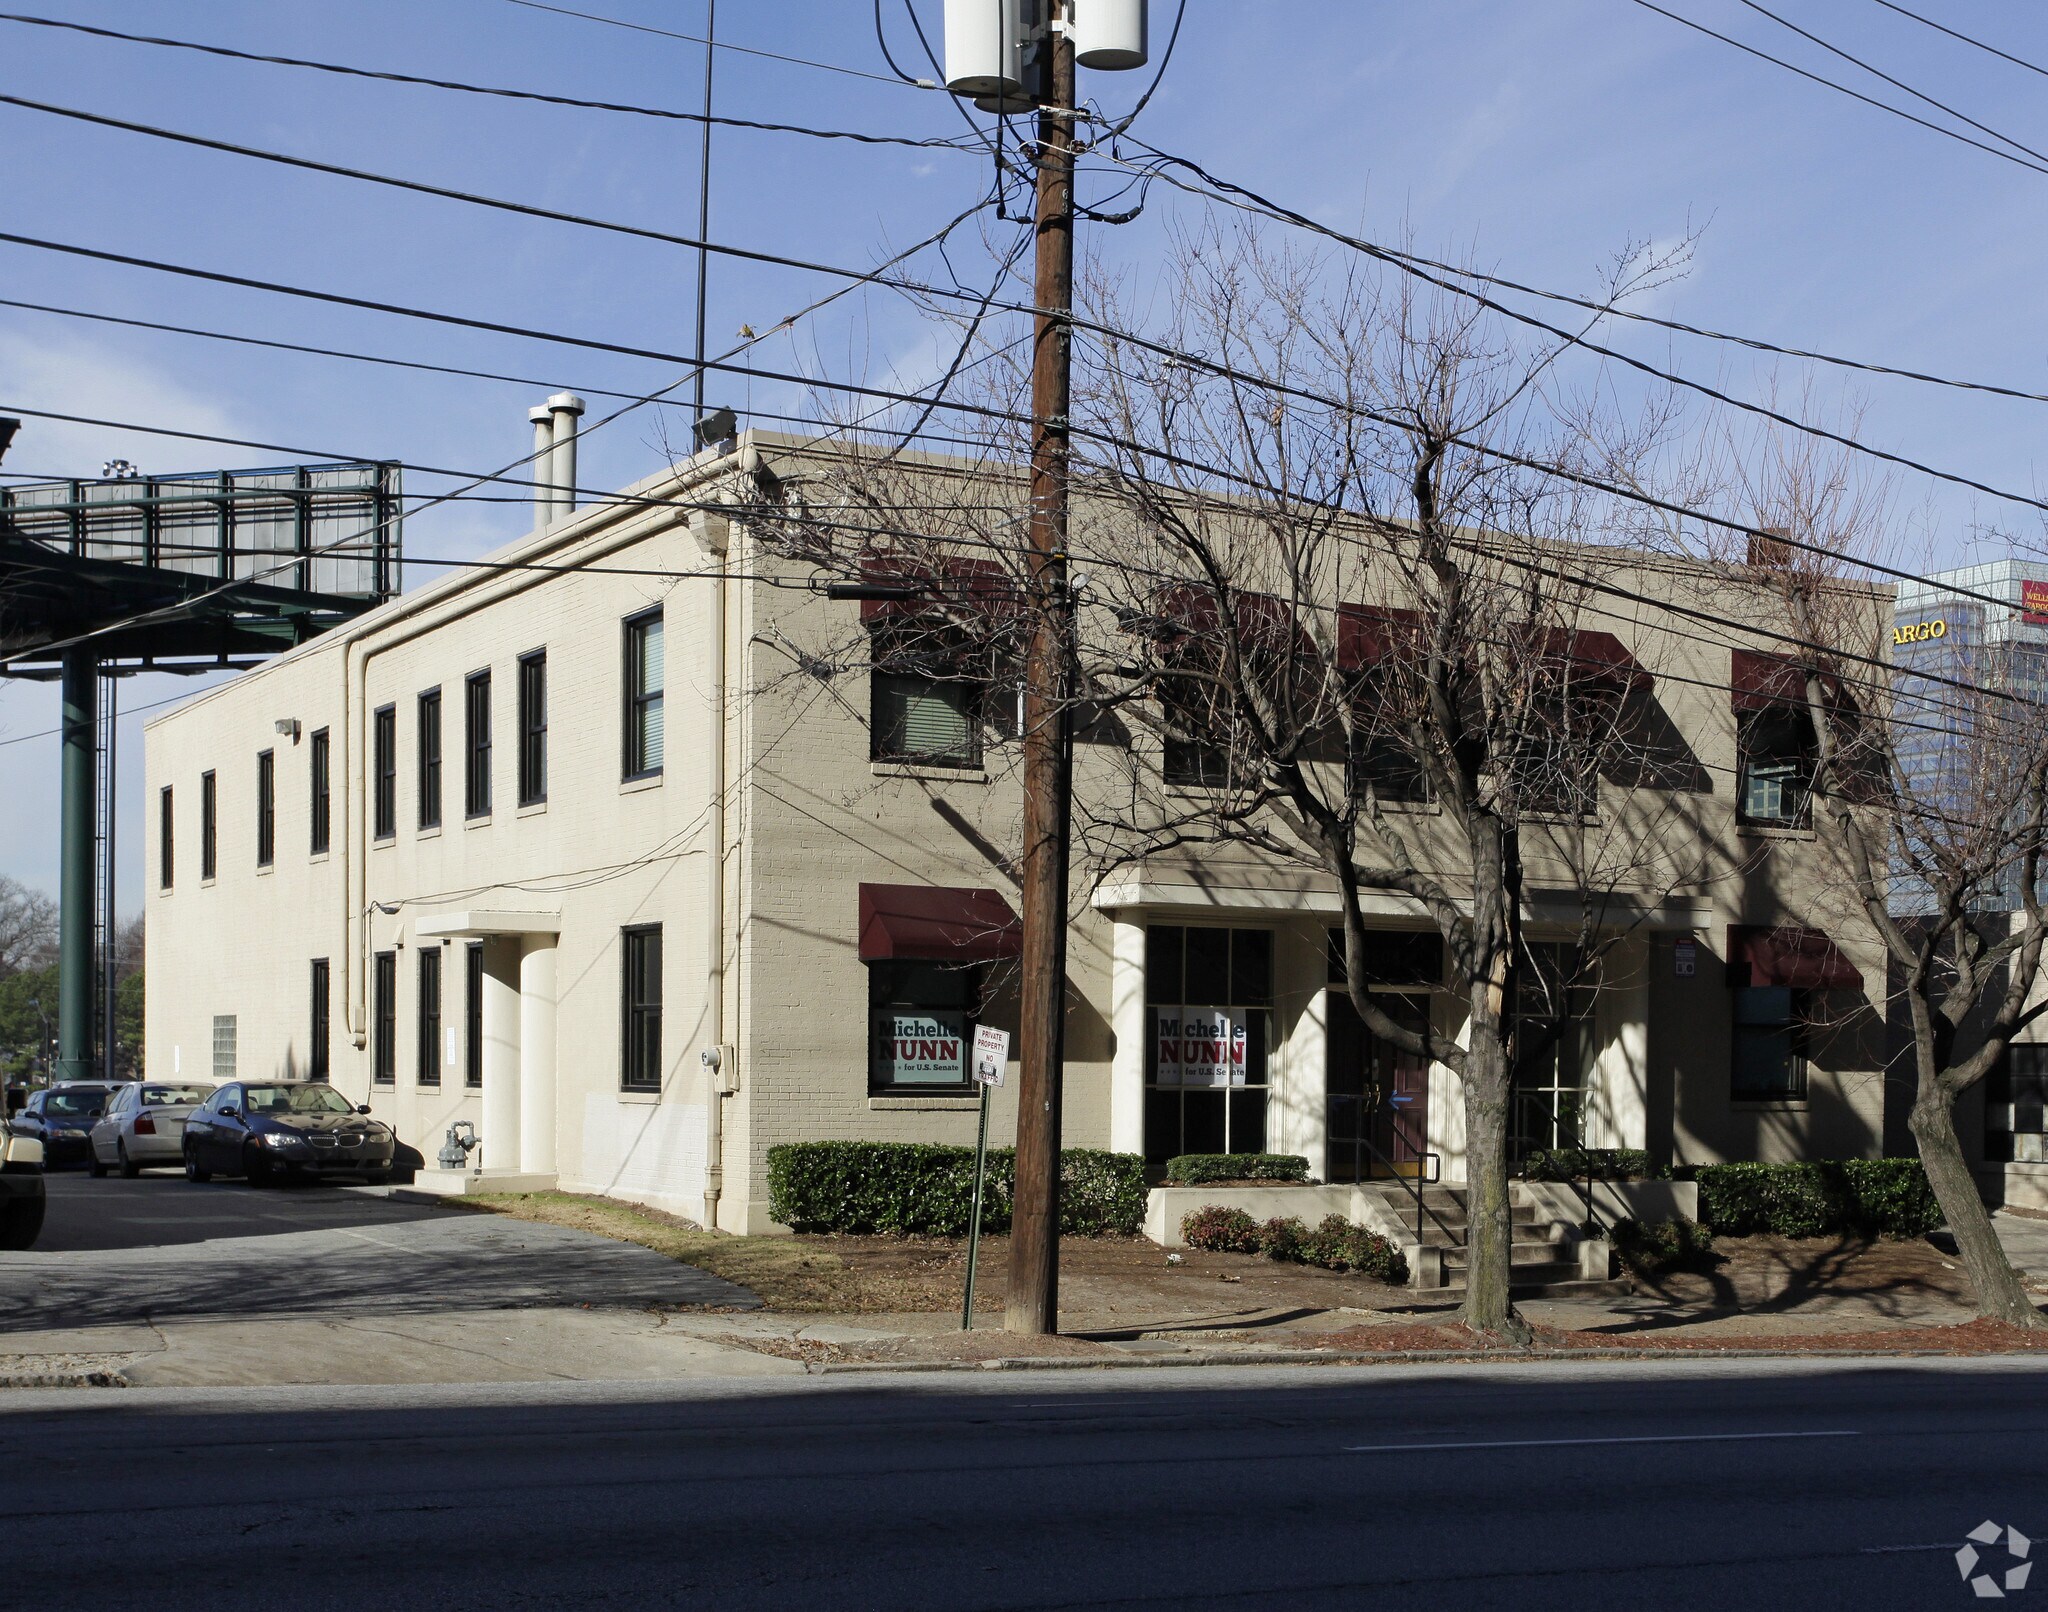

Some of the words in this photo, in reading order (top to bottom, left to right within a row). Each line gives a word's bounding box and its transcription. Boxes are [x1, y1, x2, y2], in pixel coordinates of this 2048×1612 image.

[878, 1020, 959, 1037] Michelle
[1160, 1019, 1245, 1038] Mchele
[982, 1030, 1003, 1042] PRIVATE
[878, 1040, 958, 1060] NUNN
[978, 1039, 1005, 1051] PROPERTY
[985, 1054, 994, 1063] NO
[1160, 1040, 1245, 1065] NUNN
[978, 1071, 999, 1084] TRAFFIC
[1185, 1067, 1196, 1075] for
[1198, 1067, 1215, 1076] U.S.
[1216, 1067, 1245, 1076] Seate
